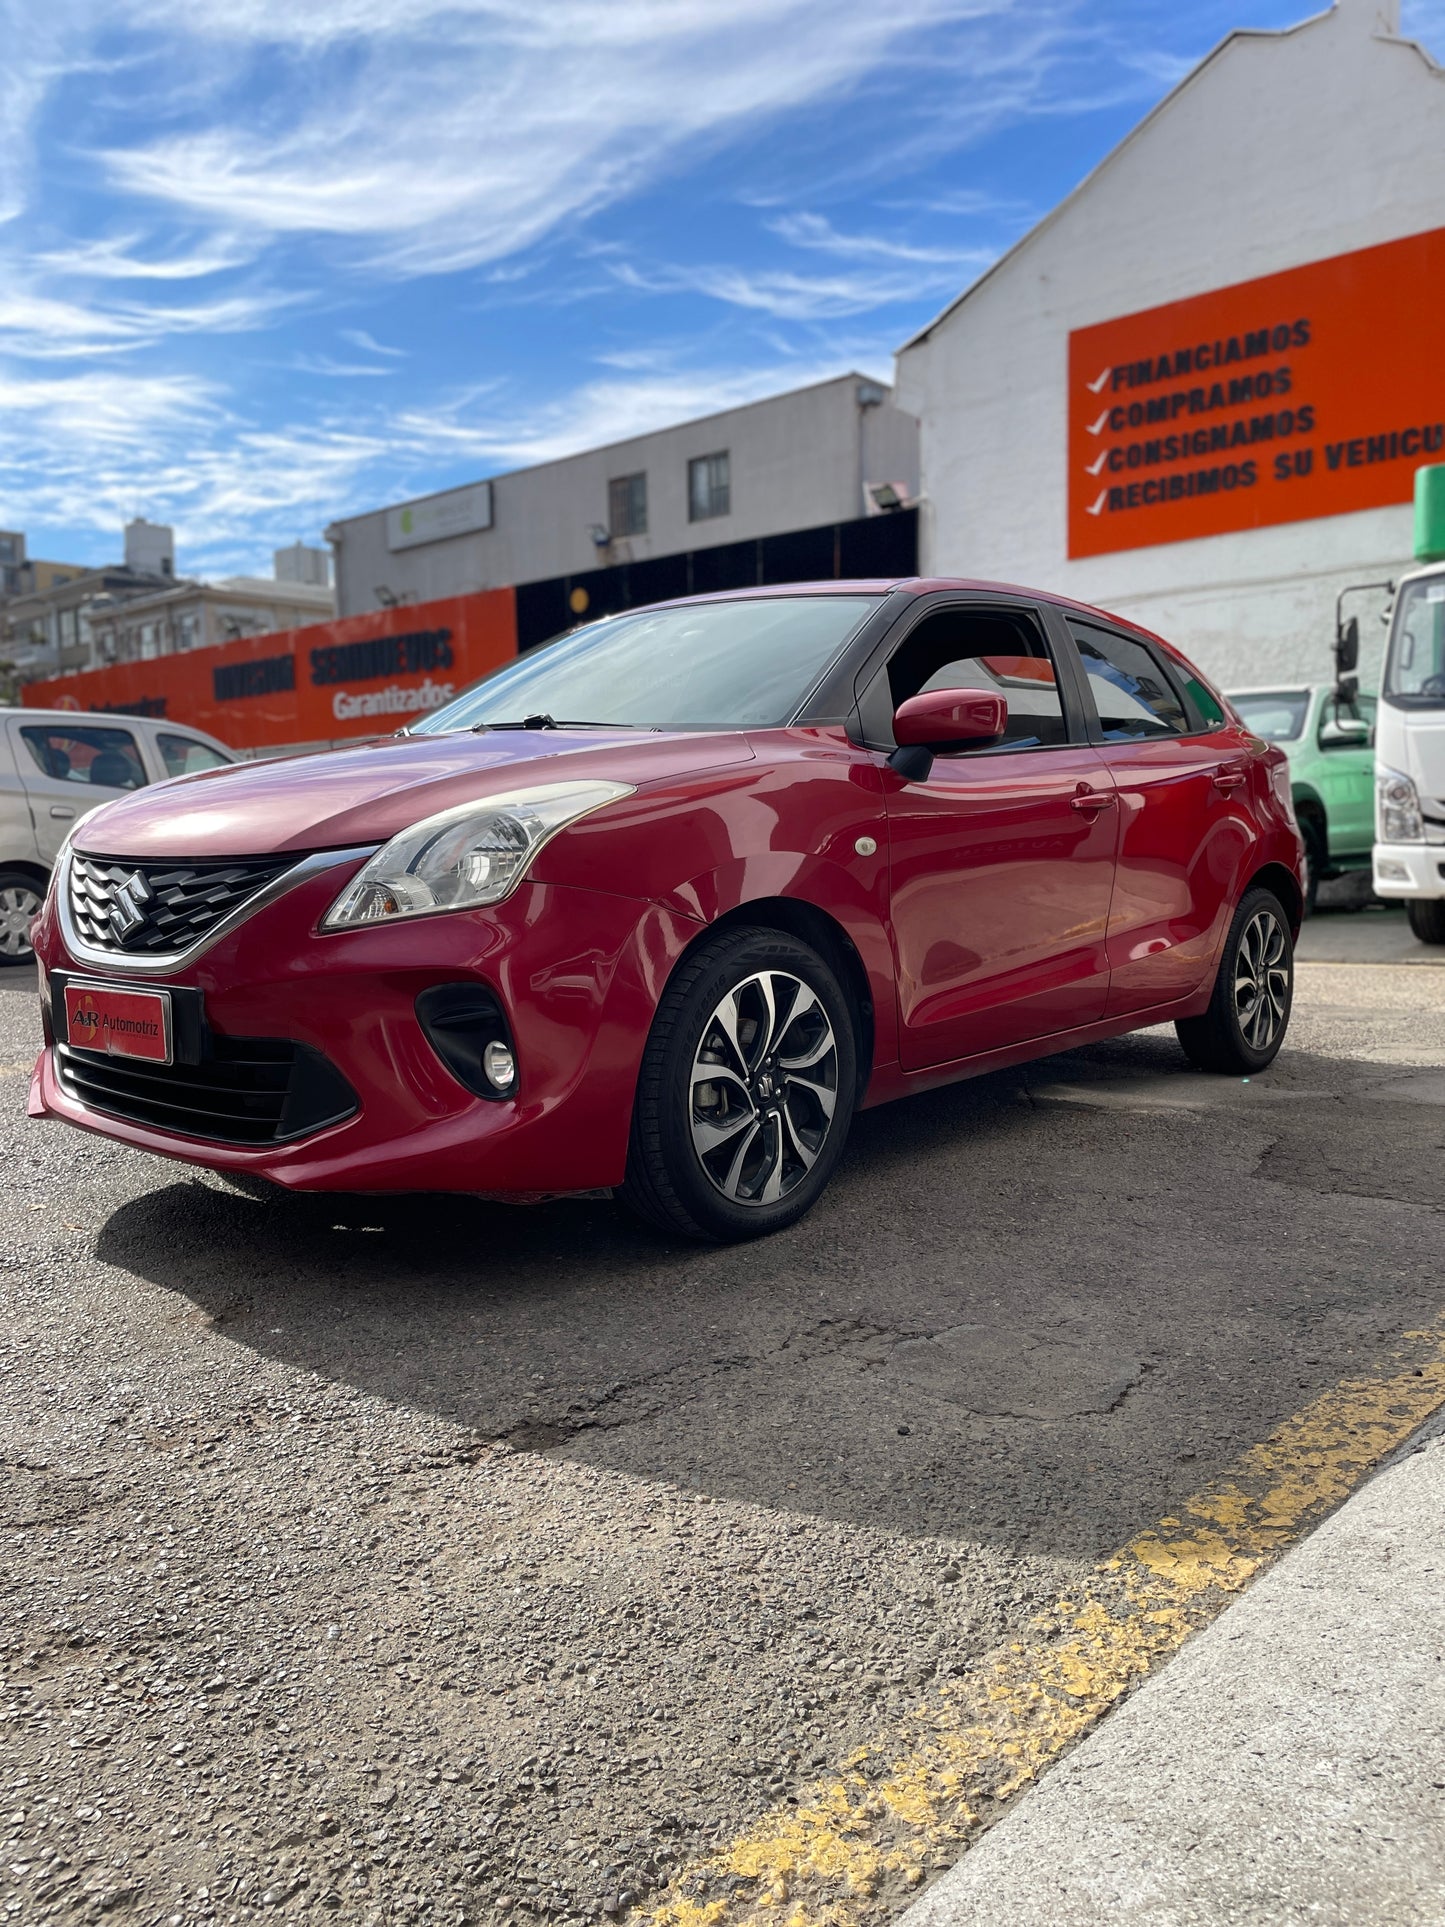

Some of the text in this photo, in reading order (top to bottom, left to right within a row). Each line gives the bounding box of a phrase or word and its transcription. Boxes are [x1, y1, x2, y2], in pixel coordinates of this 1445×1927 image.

[1111, 320, 1310, 392] FINANCIAMOS
[1108, 367, 1293, 432] COMPRAMOS
[1108, 405, 1315, 473] CONSIGNAMOS
[1108, 424, 1444, 513] RECIBIMOS SU VEHICU
[333, 679, 454, 719] Garantizados
[103, 1014, 158, 1035] Automotriz
